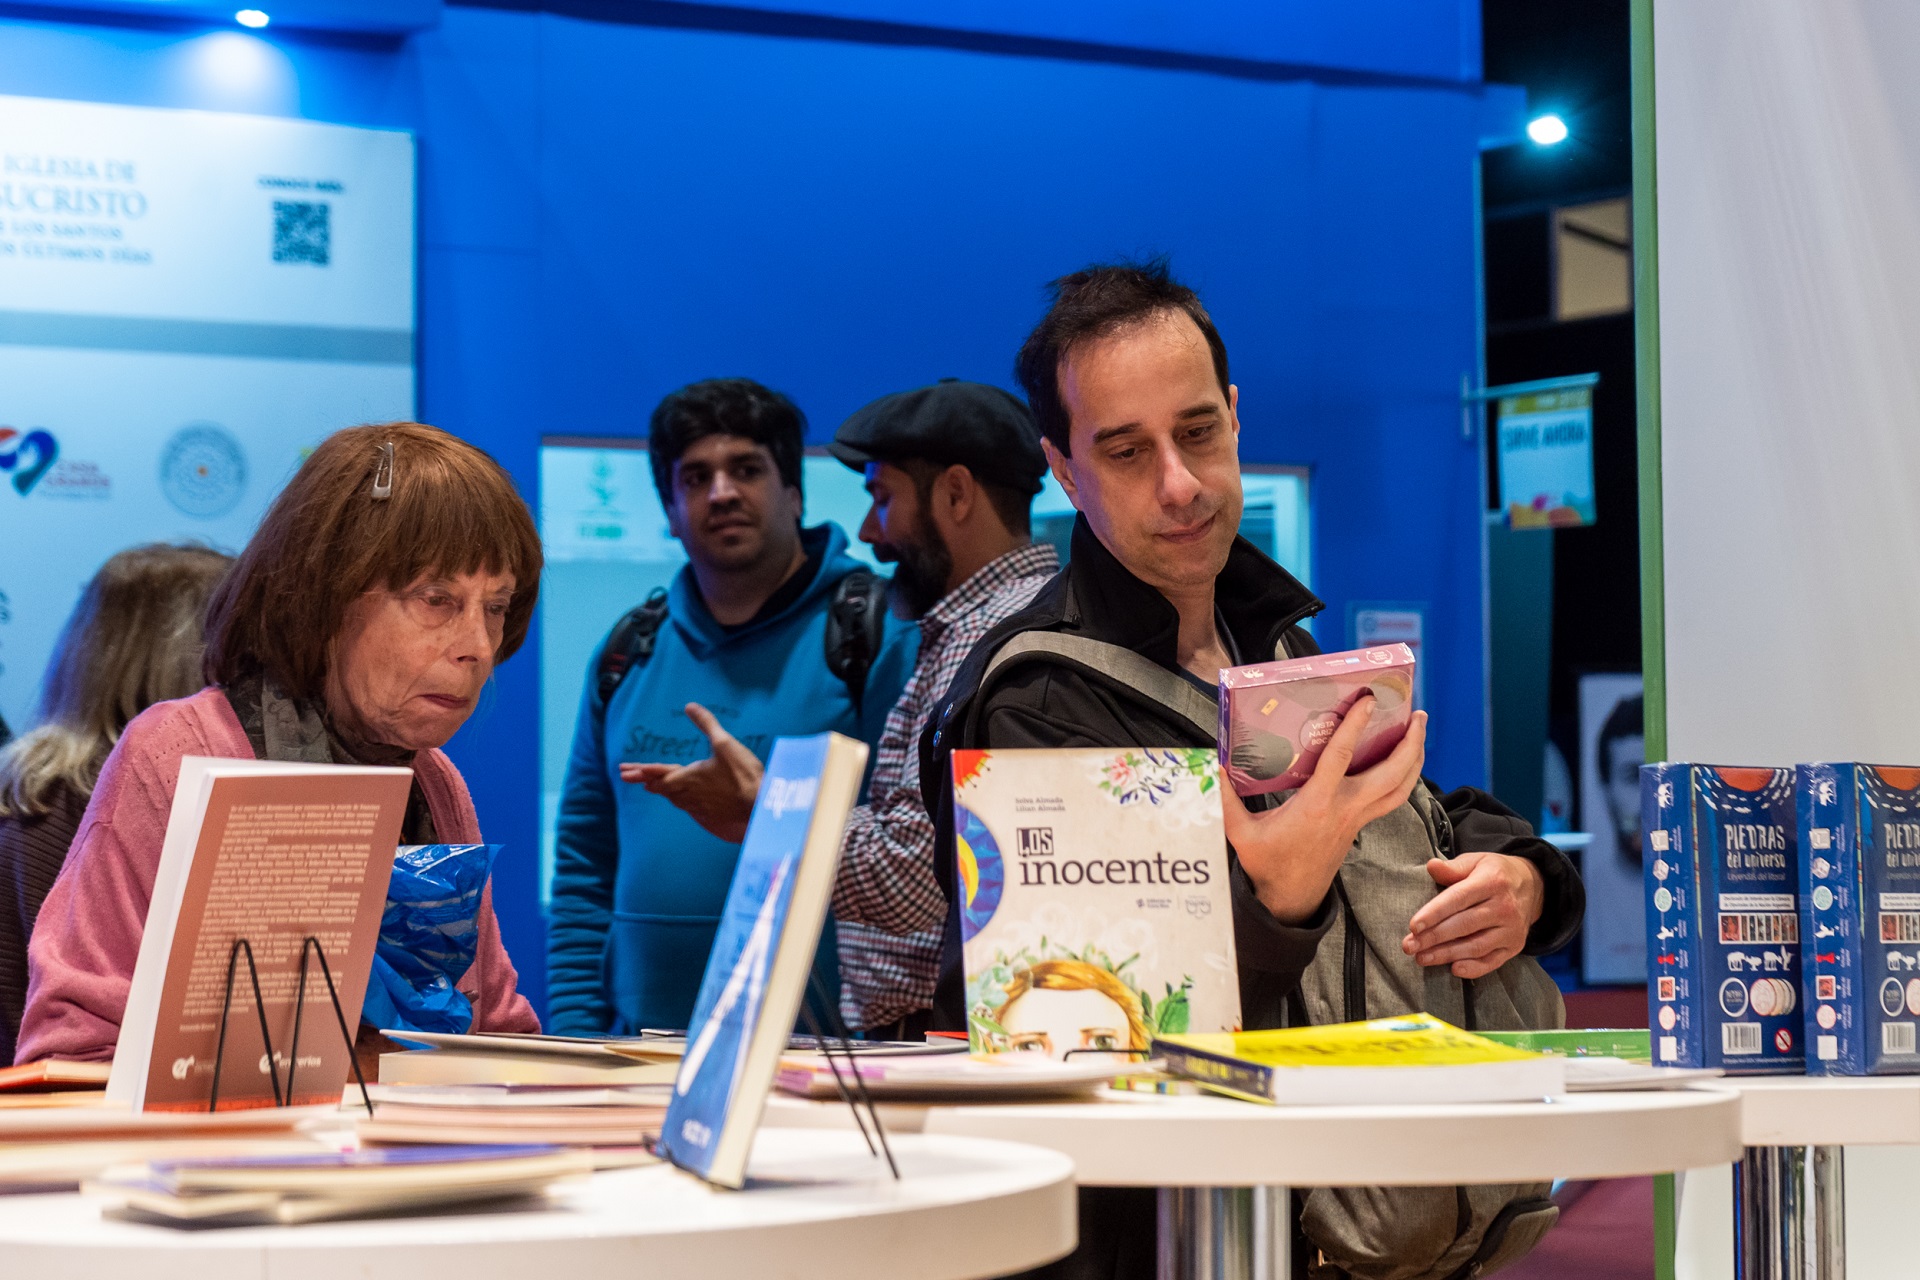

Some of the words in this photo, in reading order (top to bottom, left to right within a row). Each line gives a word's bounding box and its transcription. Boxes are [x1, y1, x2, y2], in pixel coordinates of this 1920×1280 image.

[0, 183, 149, 220] UCRISTO
[1311, 720, 1335, 730] VISTA
[1311, 736, 1330, 746] BOC
[1017, 828, 1054, 856] LOS
[1724, 823, 1786, 850] PIEDRAS
[1018, 851, 1210, 886] inocentes
[1727, 851, 1742, 868] del
[1744, 851, 1785, 868] universo
[1886, 851, 1899, 868] del
